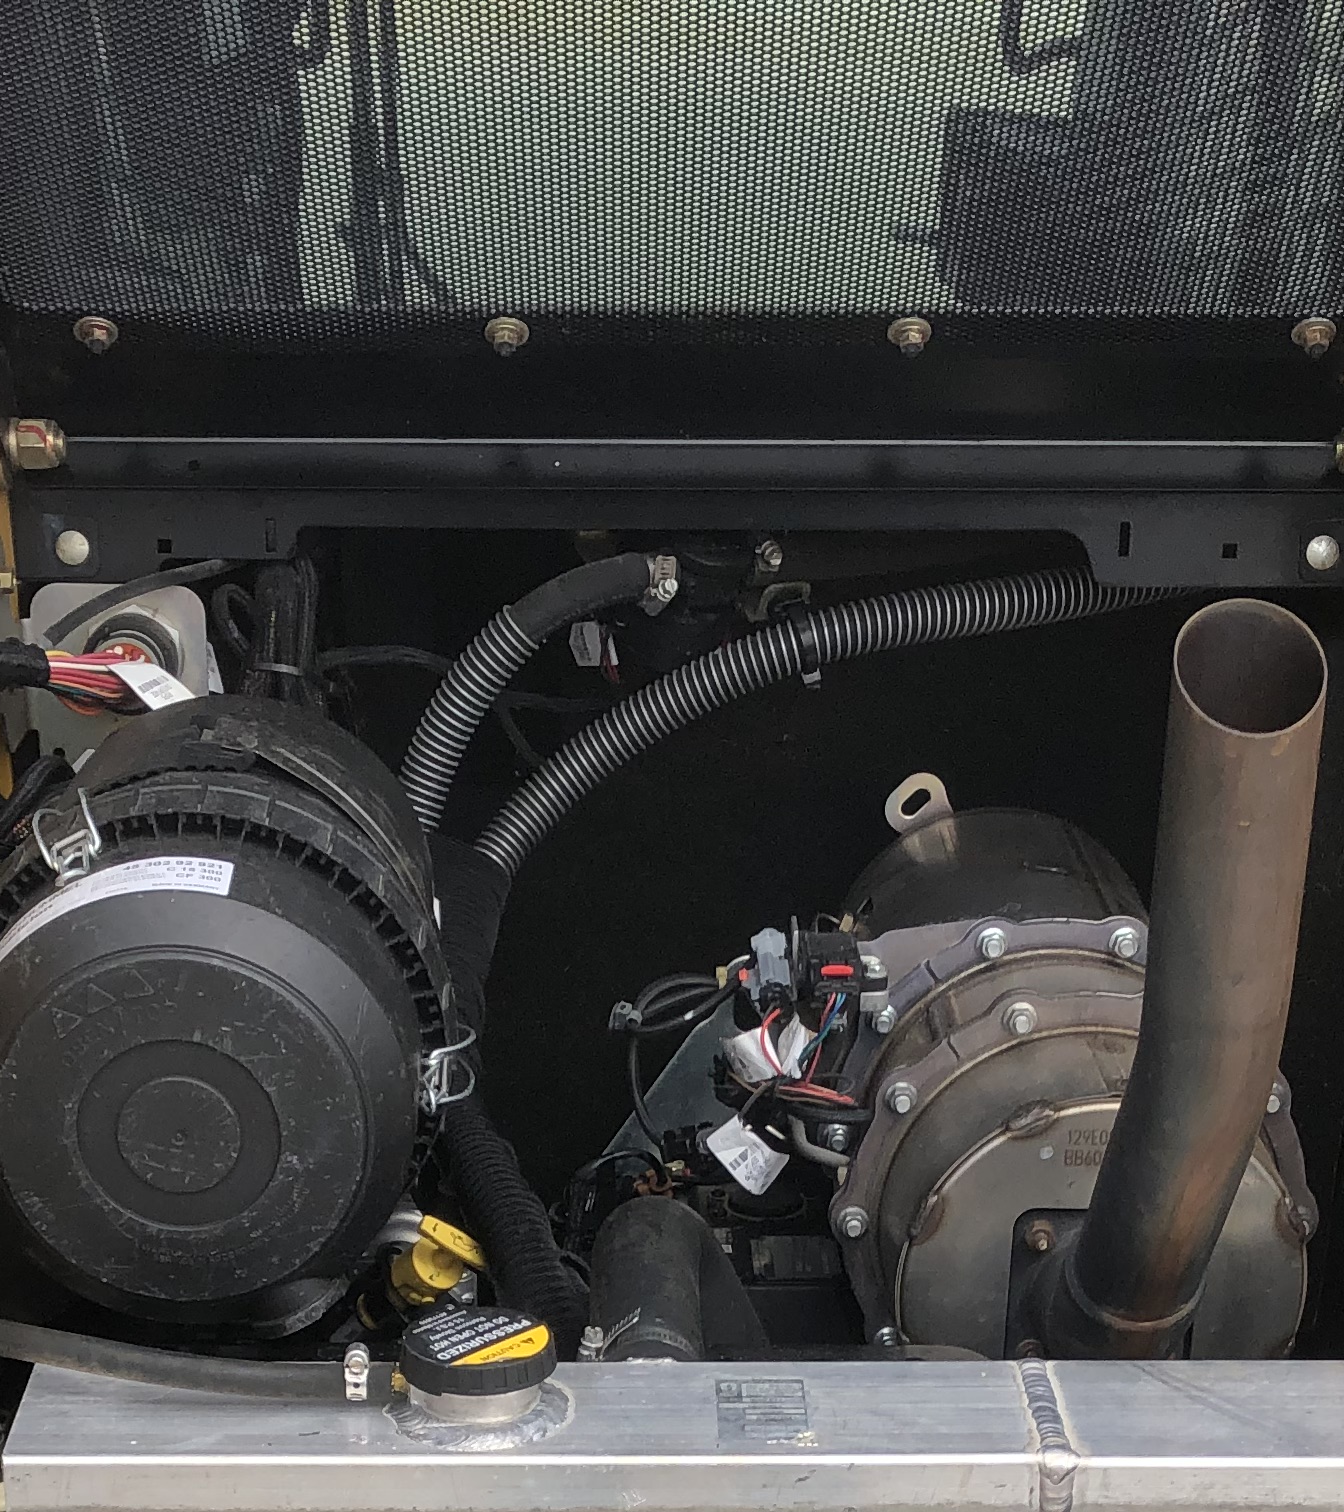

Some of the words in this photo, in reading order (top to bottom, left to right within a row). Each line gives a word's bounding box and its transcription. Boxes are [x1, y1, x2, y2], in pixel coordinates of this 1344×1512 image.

[1068, 1129, 1110, 1146] 129E0
[1064, 1149, 1103, 1167] BB60
[474, 1321, 494, 1333] NOT
[436, 1319, 532, 1361] PRESSURIZED
[449, 1330, 476, 1342] OPEN
[430, 1339, 451, 1351] HOT
[479, 1343, 521, 1362] CAUTION
